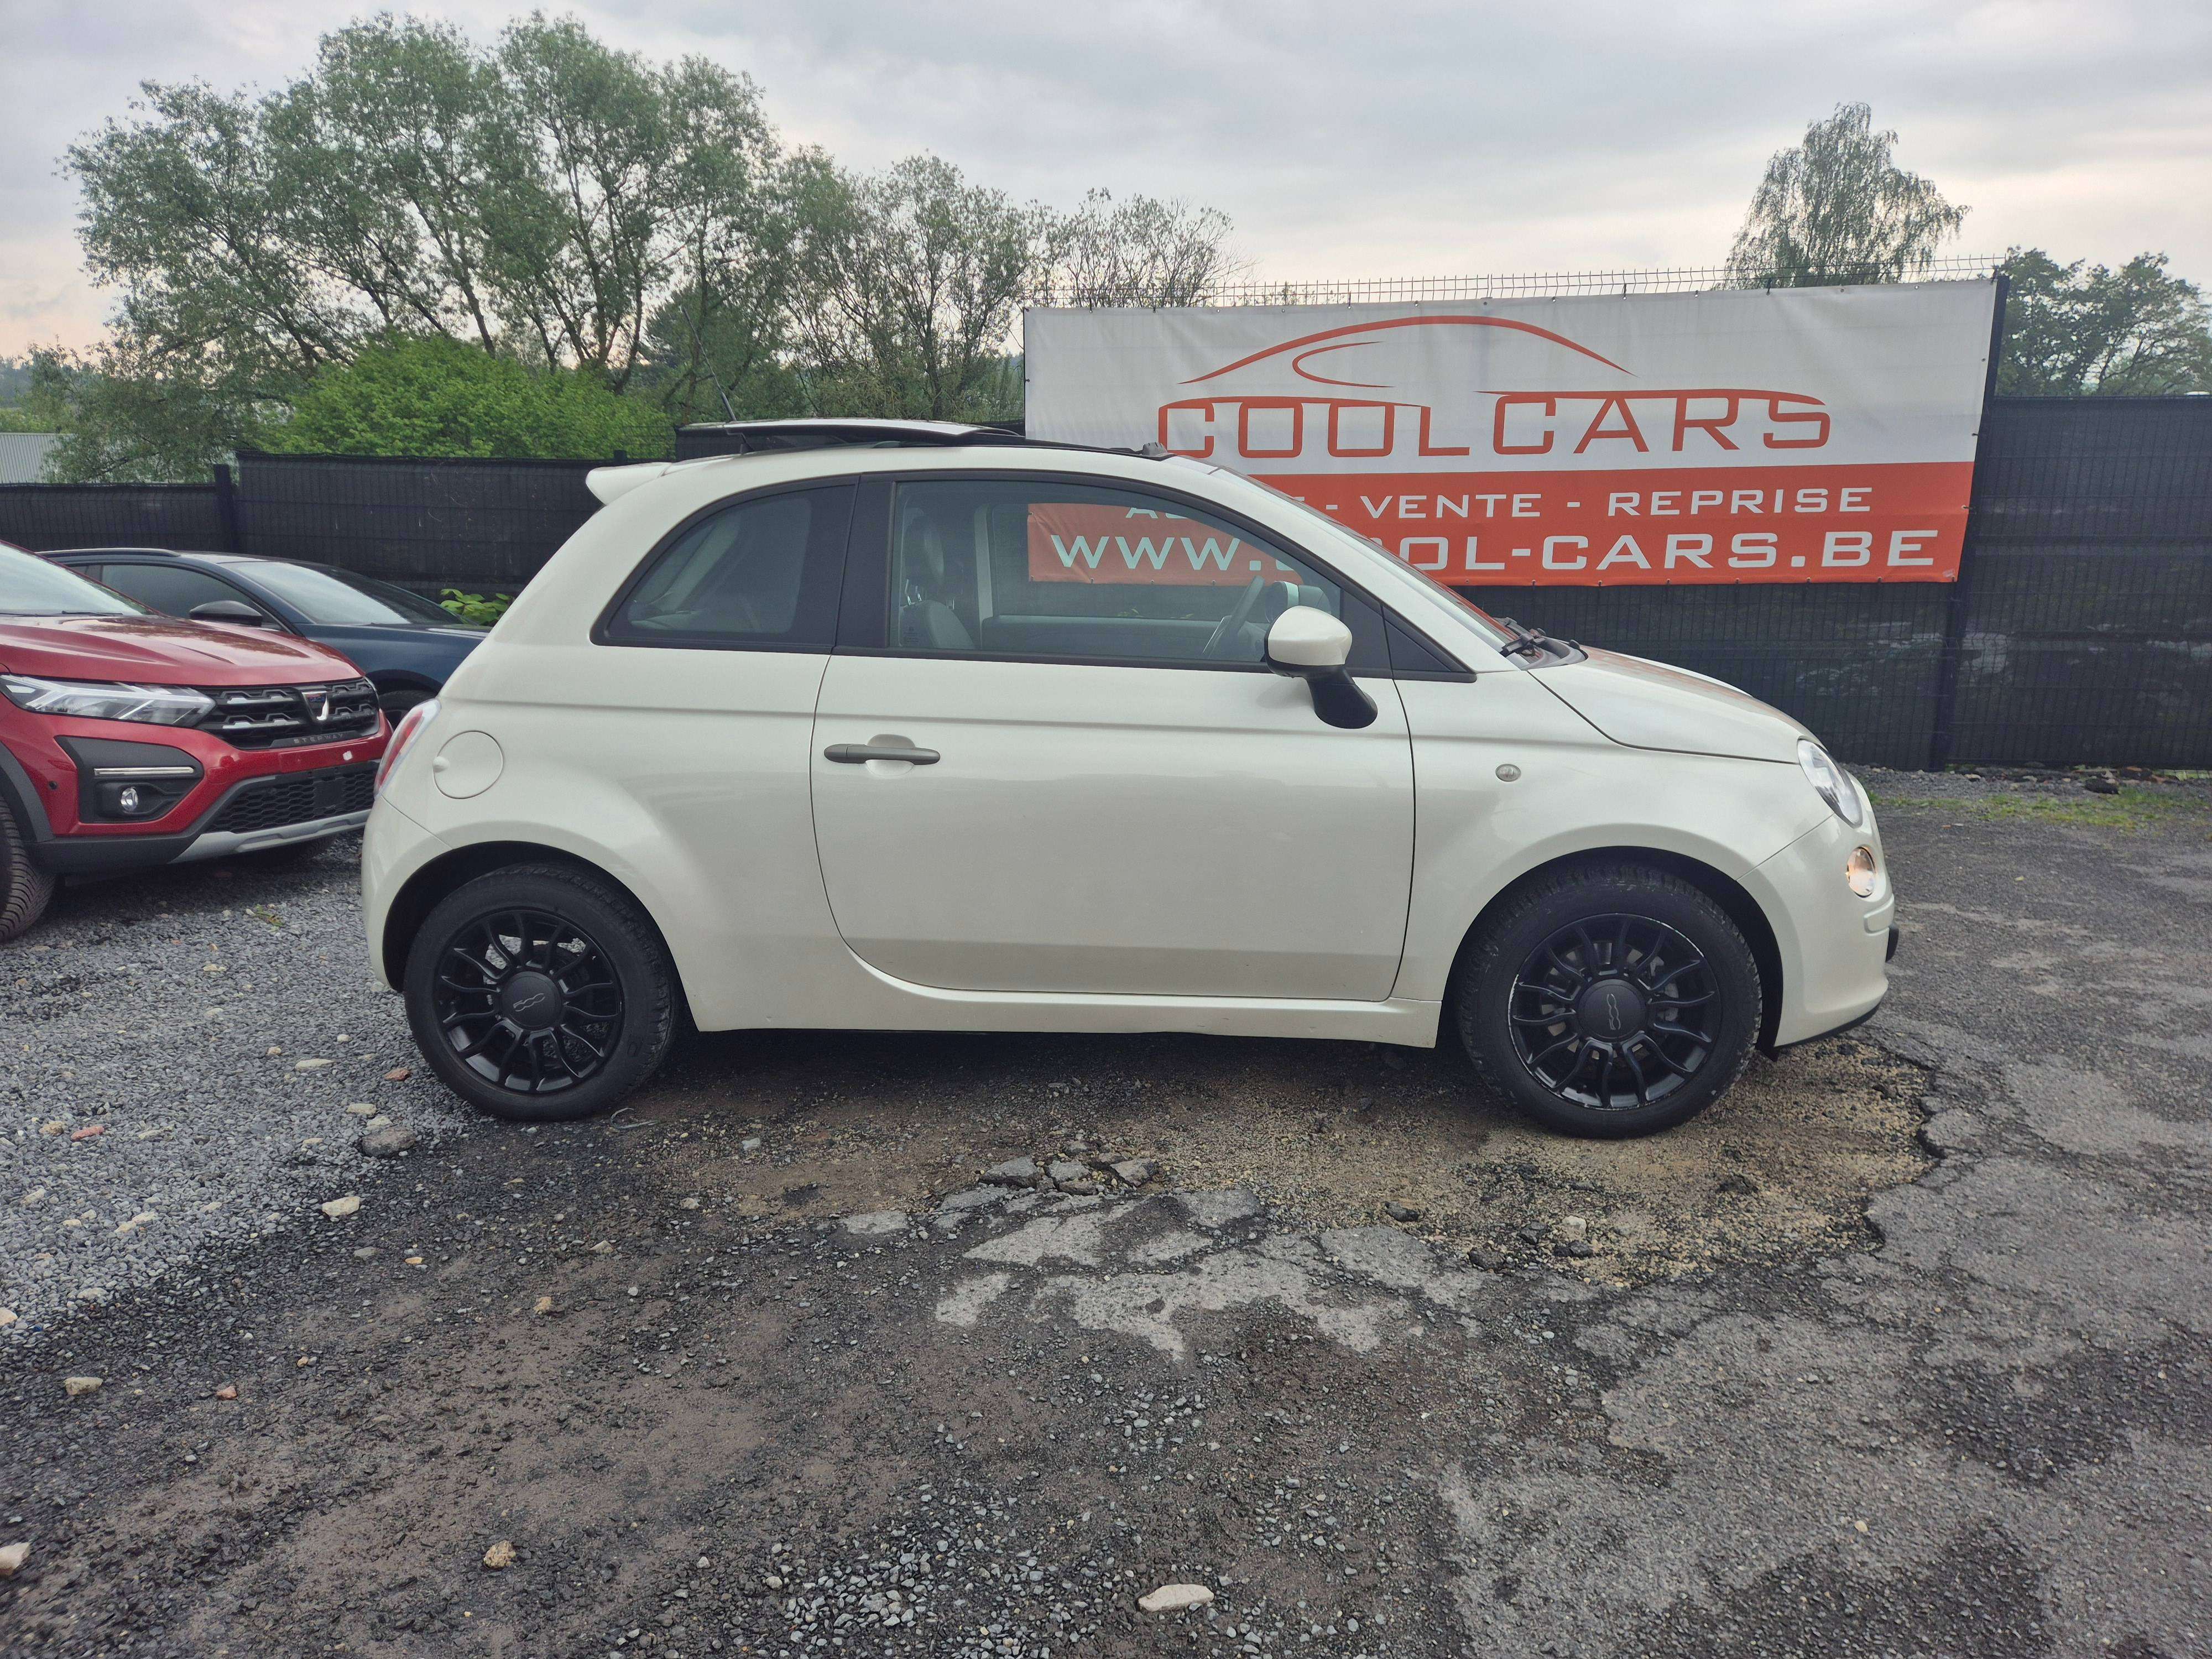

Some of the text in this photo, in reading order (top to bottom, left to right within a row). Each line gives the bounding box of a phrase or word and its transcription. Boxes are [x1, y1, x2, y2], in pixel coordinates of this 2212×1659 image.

[1360, 494, 1541, 518] VENTE
[1608, 487, 1872, 517] REPRISE
[293, 733, 343, 744] STEPWAY
